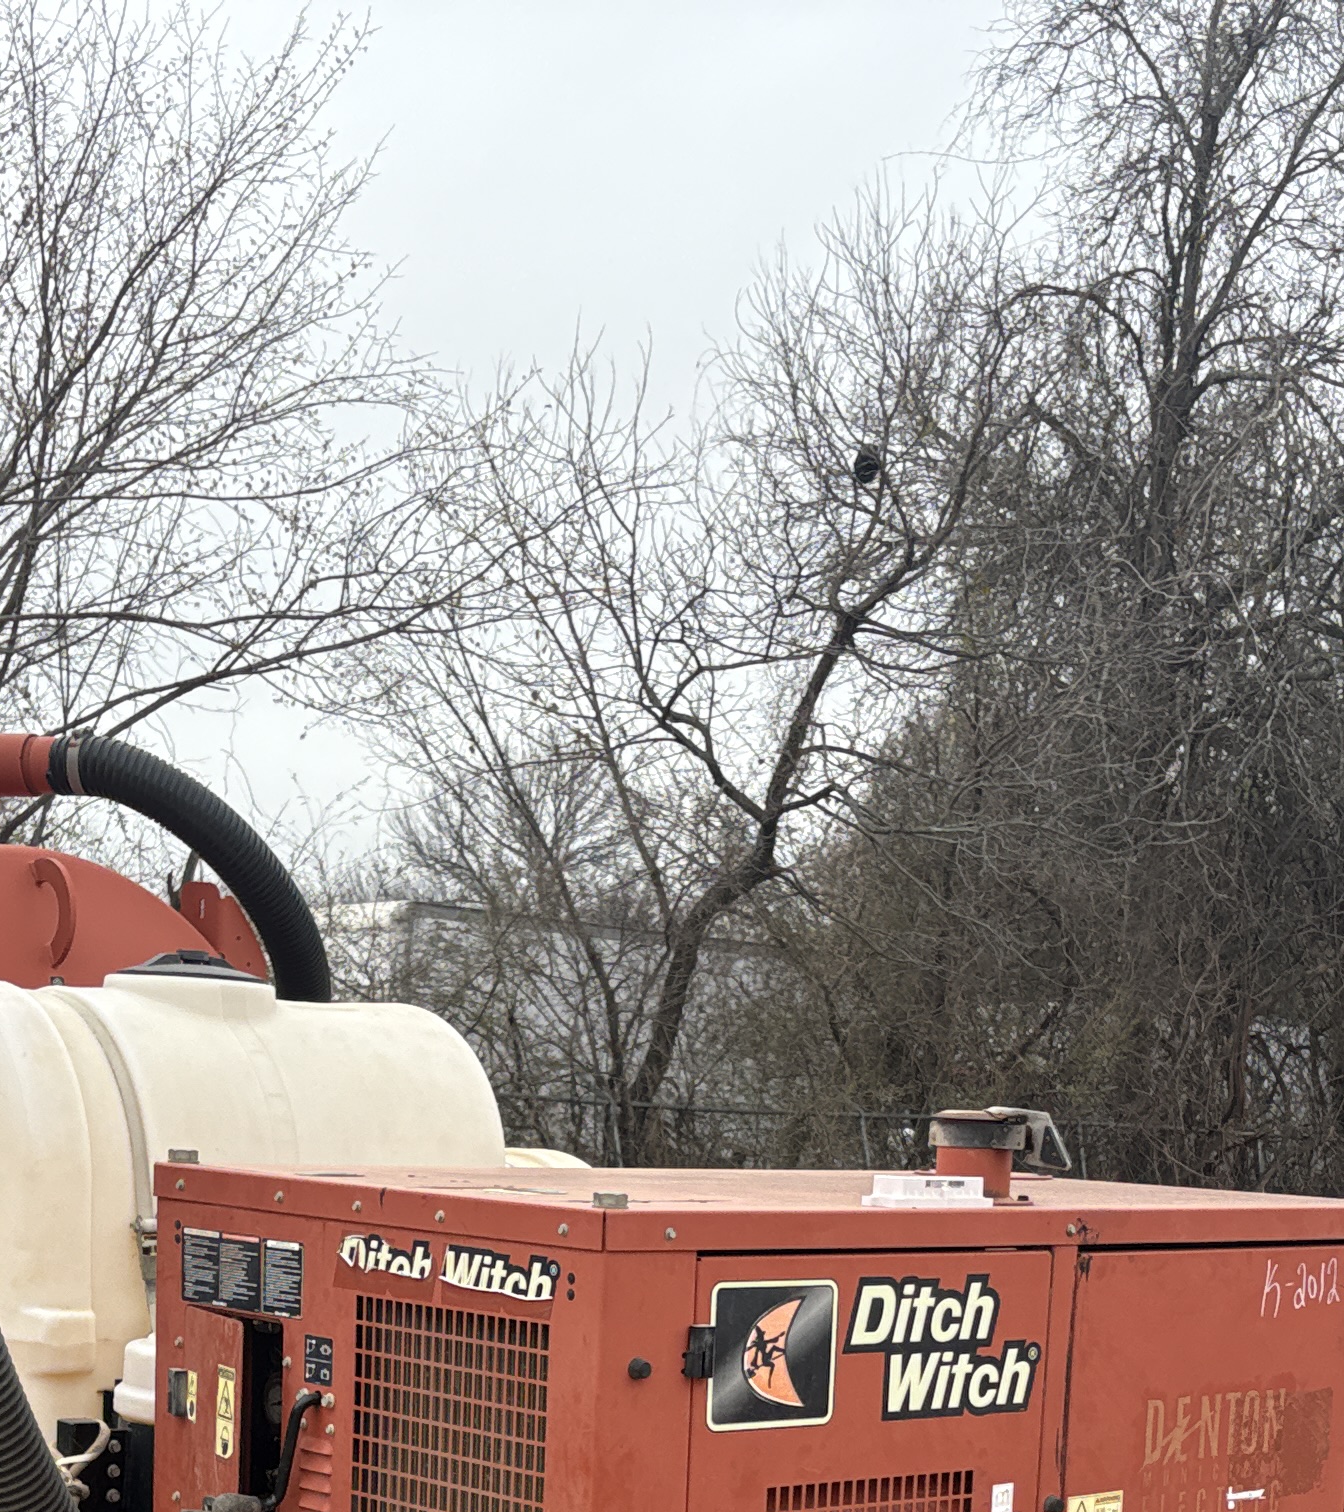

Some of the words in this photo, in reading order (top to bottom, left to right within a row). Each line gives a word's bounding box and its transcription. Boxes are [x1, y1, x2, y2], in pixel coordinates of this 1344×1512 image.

[442, 1250, 554, 1300] Witch
[1261, 1258, 1341, 1318] K-2012
[850, 1282, 995, 1345] Ditch
[887, 1348, 1030, 1413] Witch
[1140, 1387, 1287, 1472] DENTON
